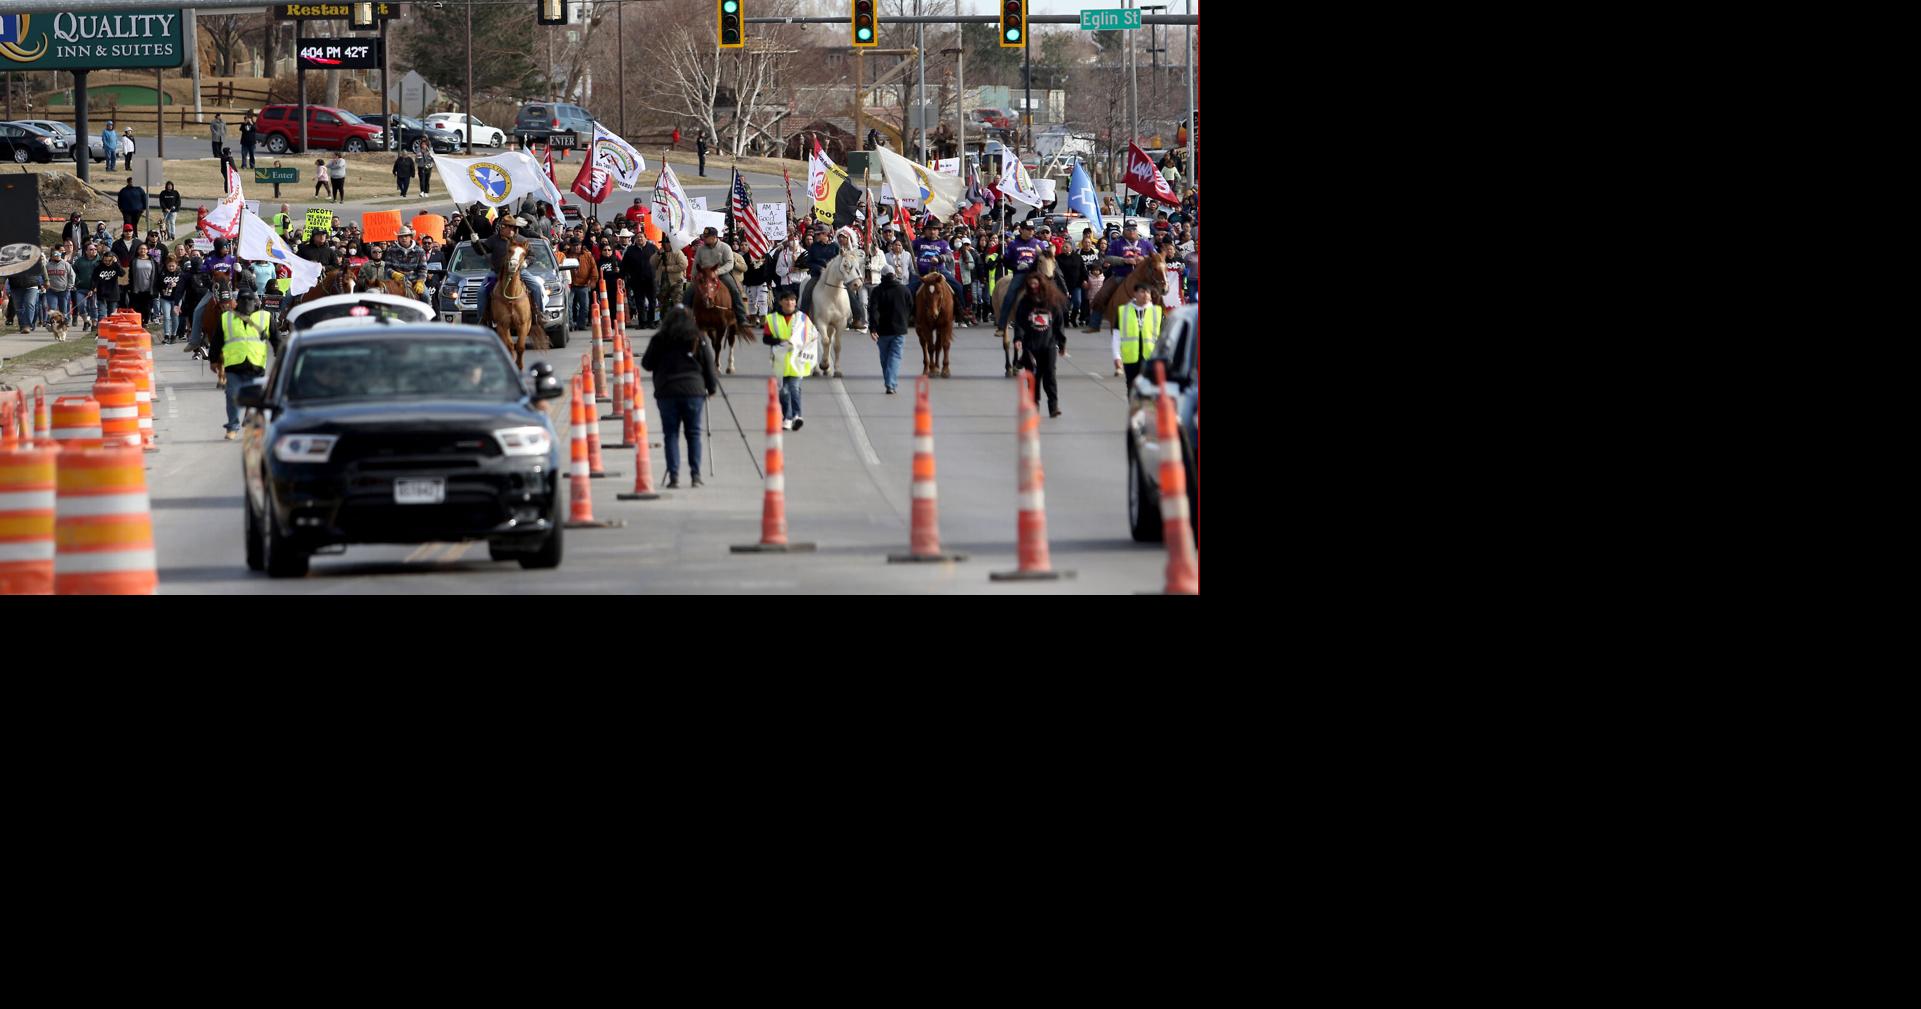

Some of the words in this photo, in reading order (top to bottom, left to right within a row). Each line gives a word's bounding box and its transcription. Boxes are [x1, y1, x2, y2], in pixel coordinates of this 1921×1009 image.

[287, 4, 389, 16] Restaut
[1082, 12, 1118, 29] Eglin
[1123, 11, 1138, 25] St
[54, 12, 174, 43] QUALITY
[57, 46, 91, 57] INN
[95, 45, 108, 57] &
[111, 44, 173, 56] SUITES
[300, 46, 324, 58] 4:04
[326, 46, 341, 58] PM
[549, 135, 576, 146] ENTER
[272, 171, 294, 179] Enter
